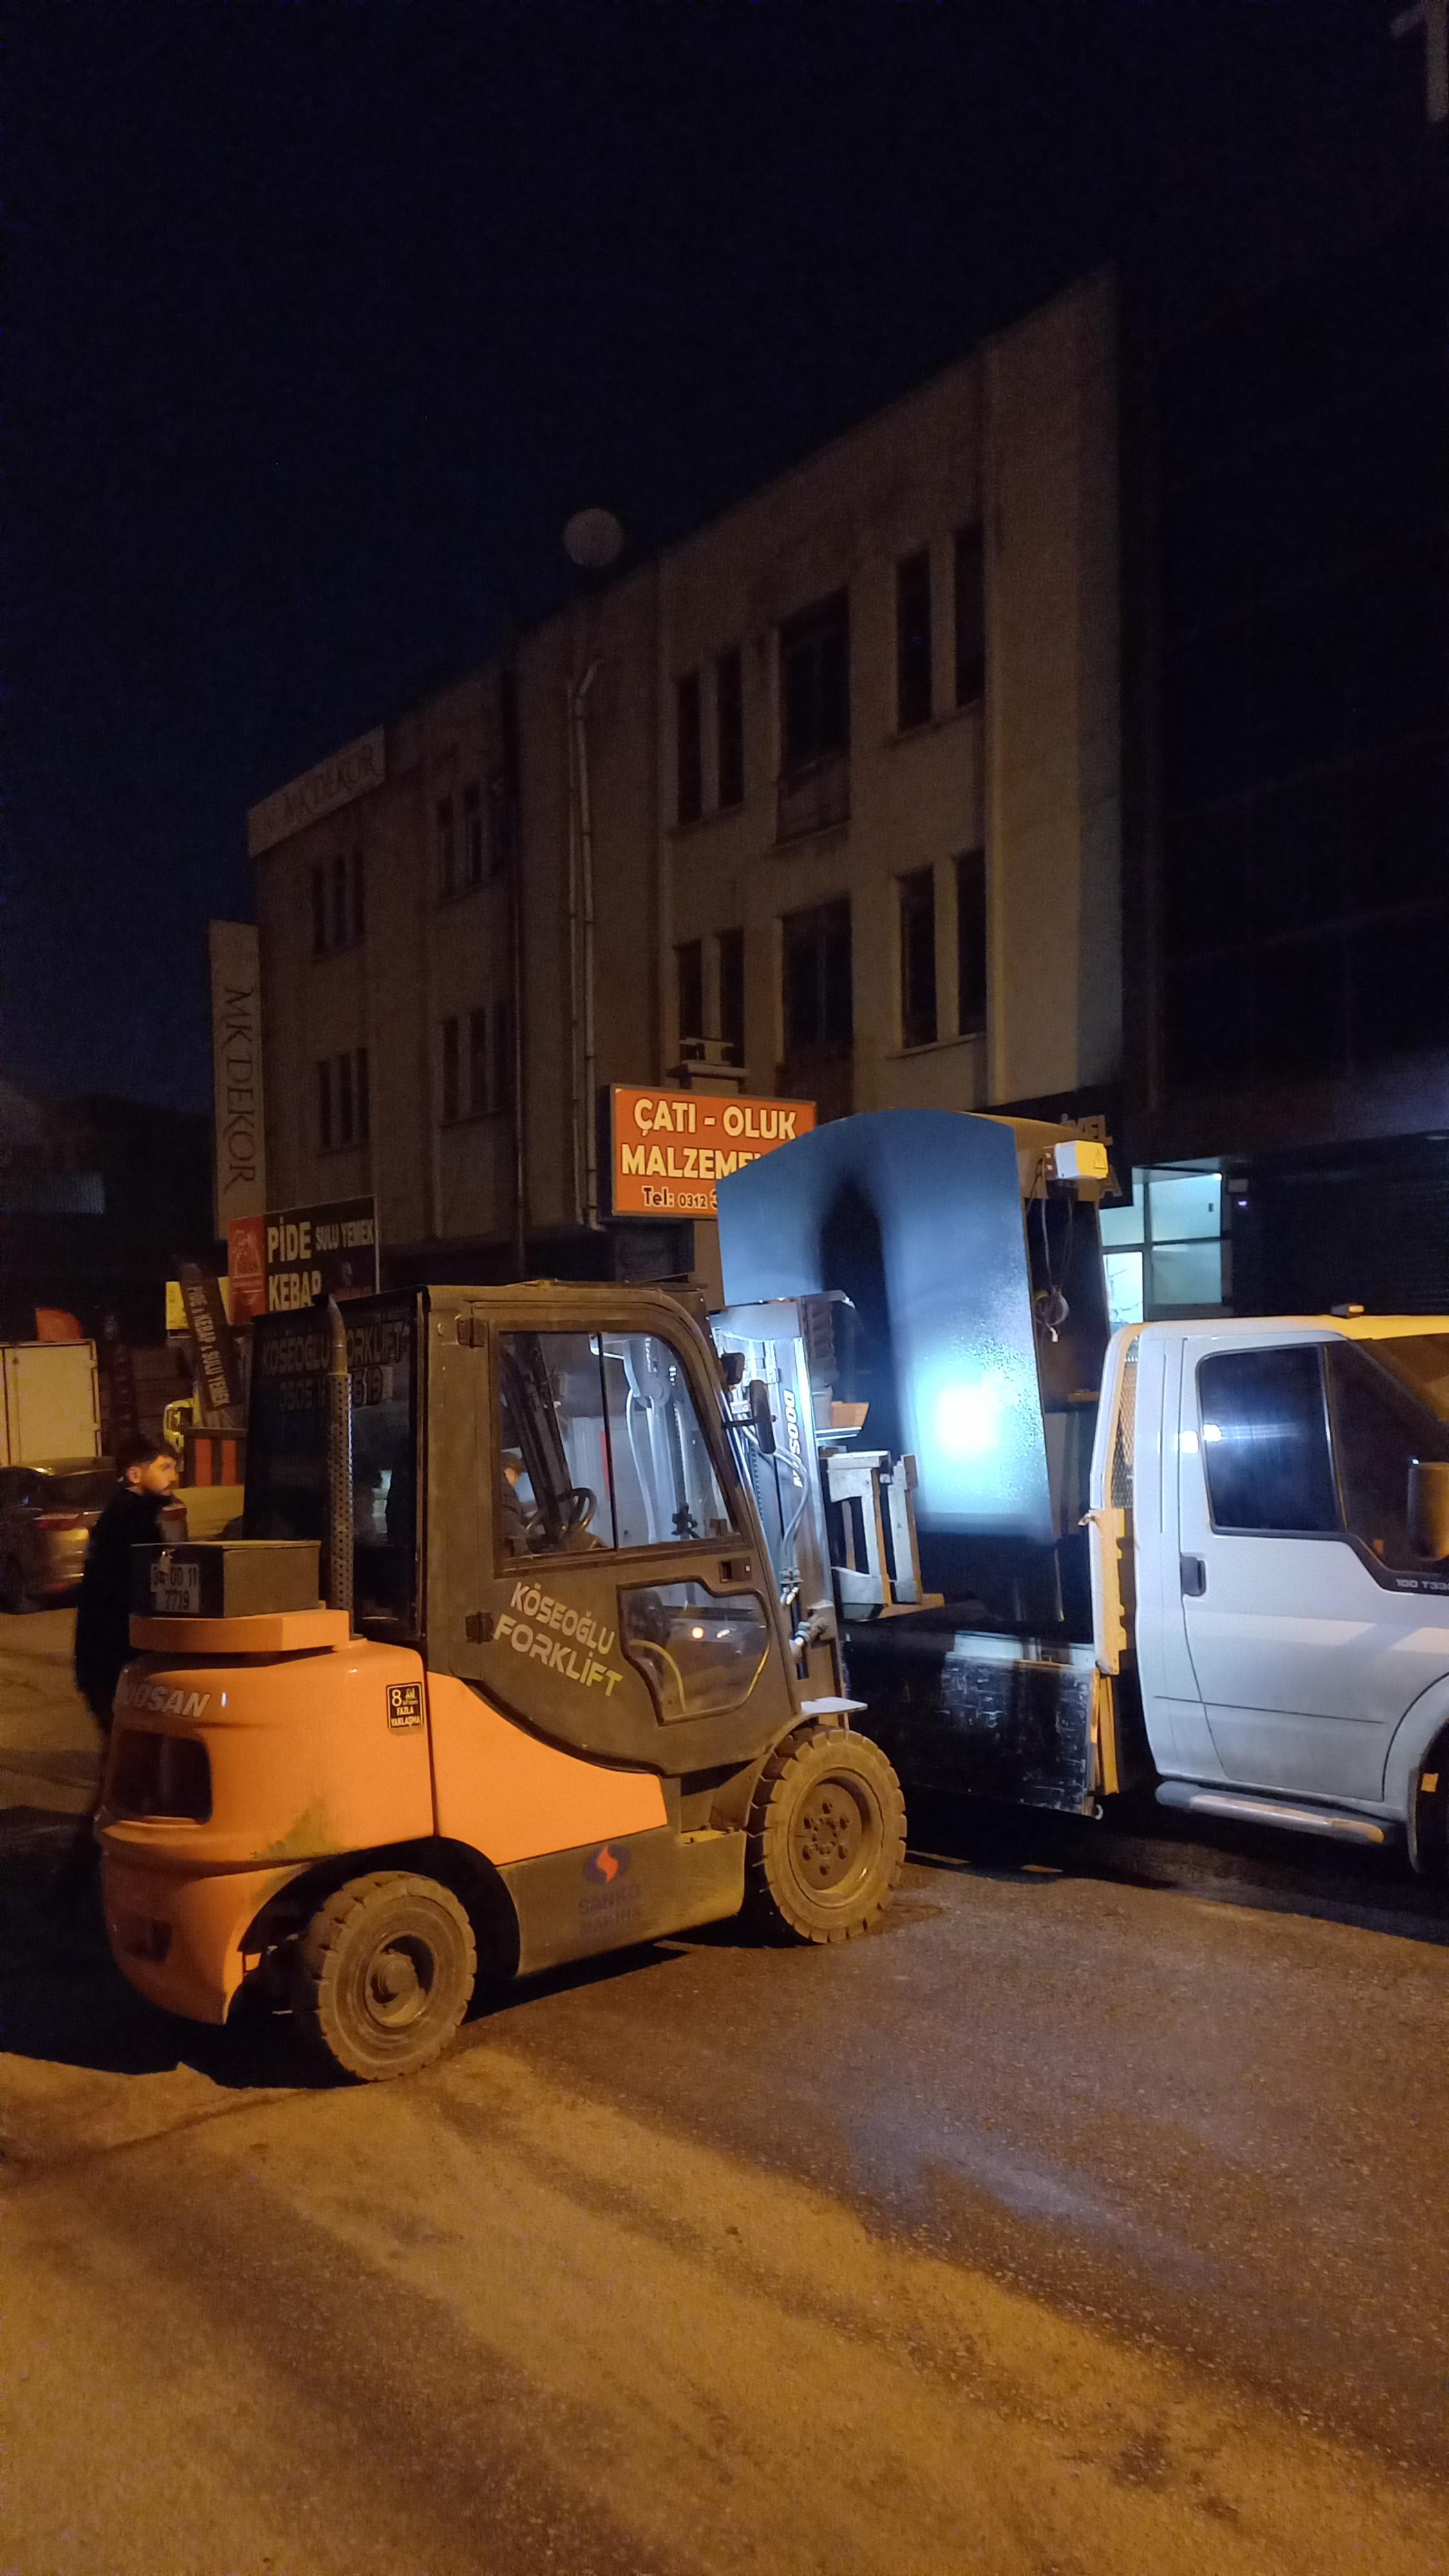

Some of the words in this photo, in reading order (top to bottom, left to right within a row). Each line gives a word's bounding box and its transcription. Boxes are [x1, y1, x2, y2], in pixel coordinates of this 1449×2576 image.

[220, 987, 256, 1051] MK
[223, 1058, 256, 1195] DEKOR
[634, 1097, 697, 1137] ÇATI
[722, 1104, 797, 1141] OLUK
[642, 1186, 674, 1208] Tel:
[678, 1193, 708, 1209] 0312
[267, 1216, 312, 1264] PİDE
[316, 1223, 340, 1251] SULU
[341, 1218, 375, 1248] YEMEK
[782, 1389, 804, 1488] DOOSN
[509, 1582, 615, 1654] KÖSEOĞLU
[493, 1613, 624, 1697] FORKLİFT
[392, 1689, 402, 1707] 8
